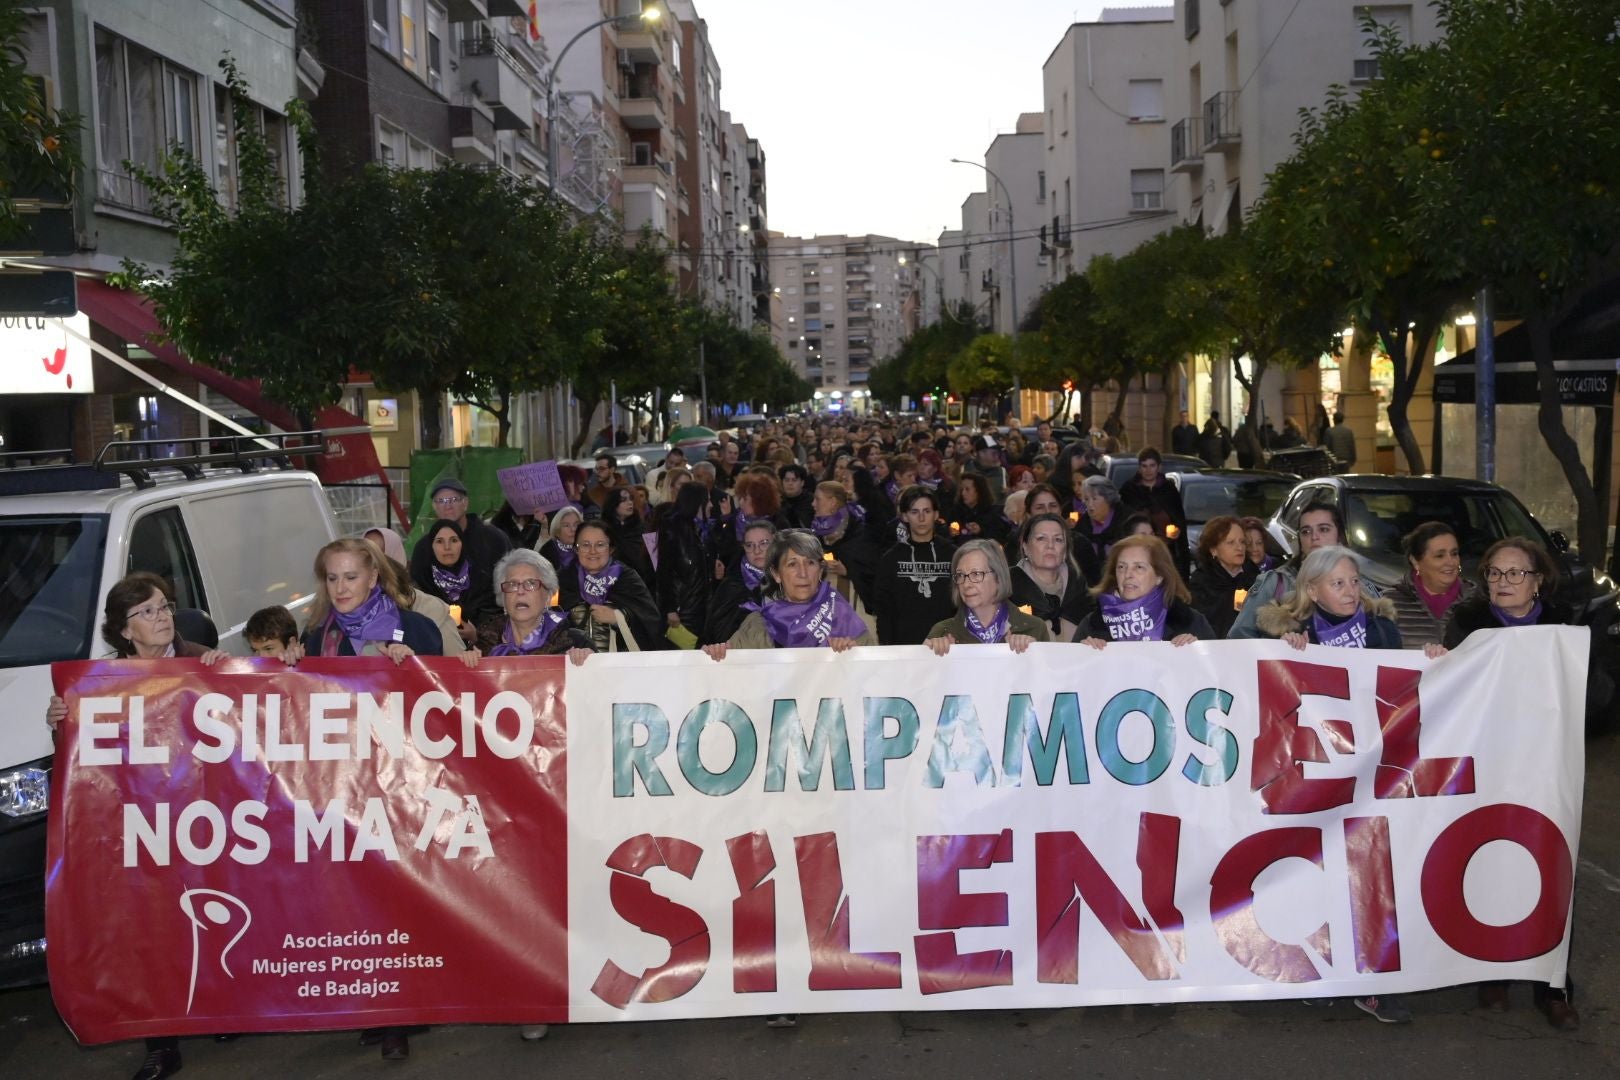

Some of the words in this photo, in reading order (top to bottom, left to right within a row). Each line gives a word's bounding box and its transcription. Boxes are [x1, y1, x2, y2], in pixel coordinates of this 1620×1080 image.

[1131, 606, 1149, 621] EL
[78, 694, 169, 767] EL
[191, 690, 535, 763] SILENCIO
[612, 687, 1240, 798] ROMPAMOS
[1250, 659, 1476, 815] EL
[122, 799, 272, 868] NOS
[294, 784, 495, 863] MATA
[590, 803, 1574, 1011] SILENCIO
[282, 930, 382, 949] Asociación
[387, 929, 410, 945] de
[252, 958, 327, 977] Mujeres
[331, 953, 444, 974] Progresistas
[297, 981, 321, 997] de
[325, 978, 400, 998] Badajoz
